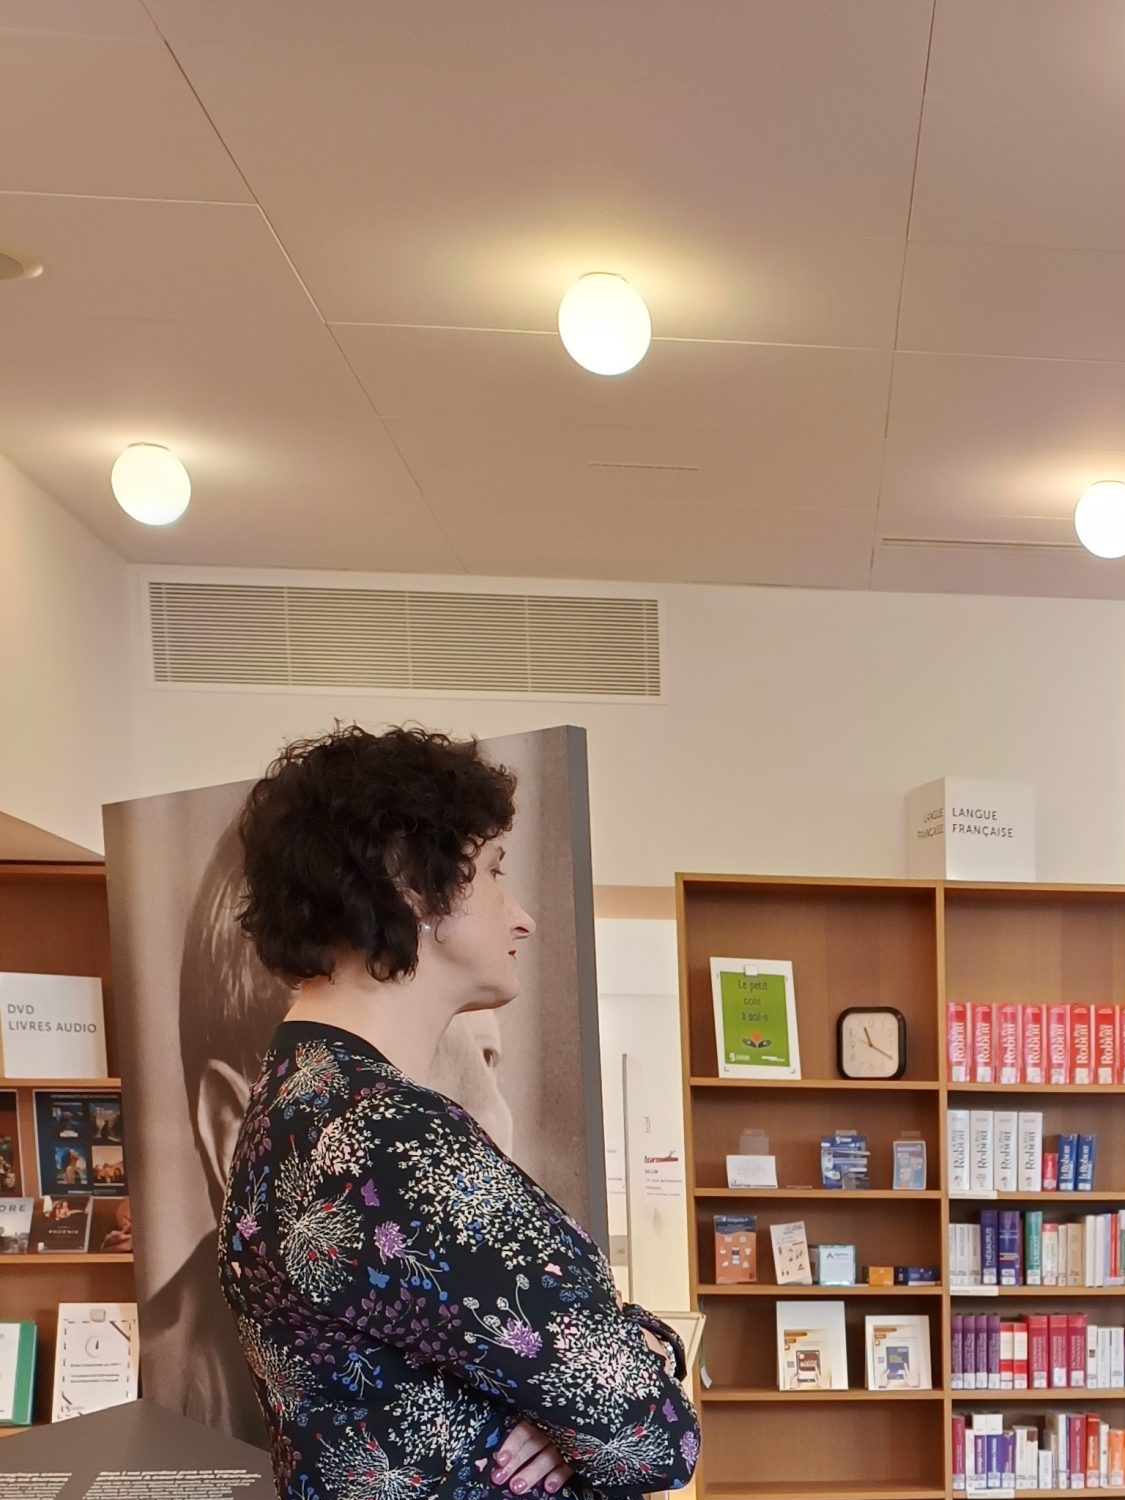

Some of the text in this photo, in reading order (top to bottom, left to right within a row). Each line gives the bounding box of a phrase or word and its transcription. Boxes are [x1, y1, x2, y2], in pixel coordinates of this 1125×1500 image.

[952, 807, 998, 821] LANGUE
[952, 823, 1014, 838] FRANÇAISE
[7, 1003, 35, 1015] DVD
[8, 1020, 97, 1034] LIVRES AUDIO
